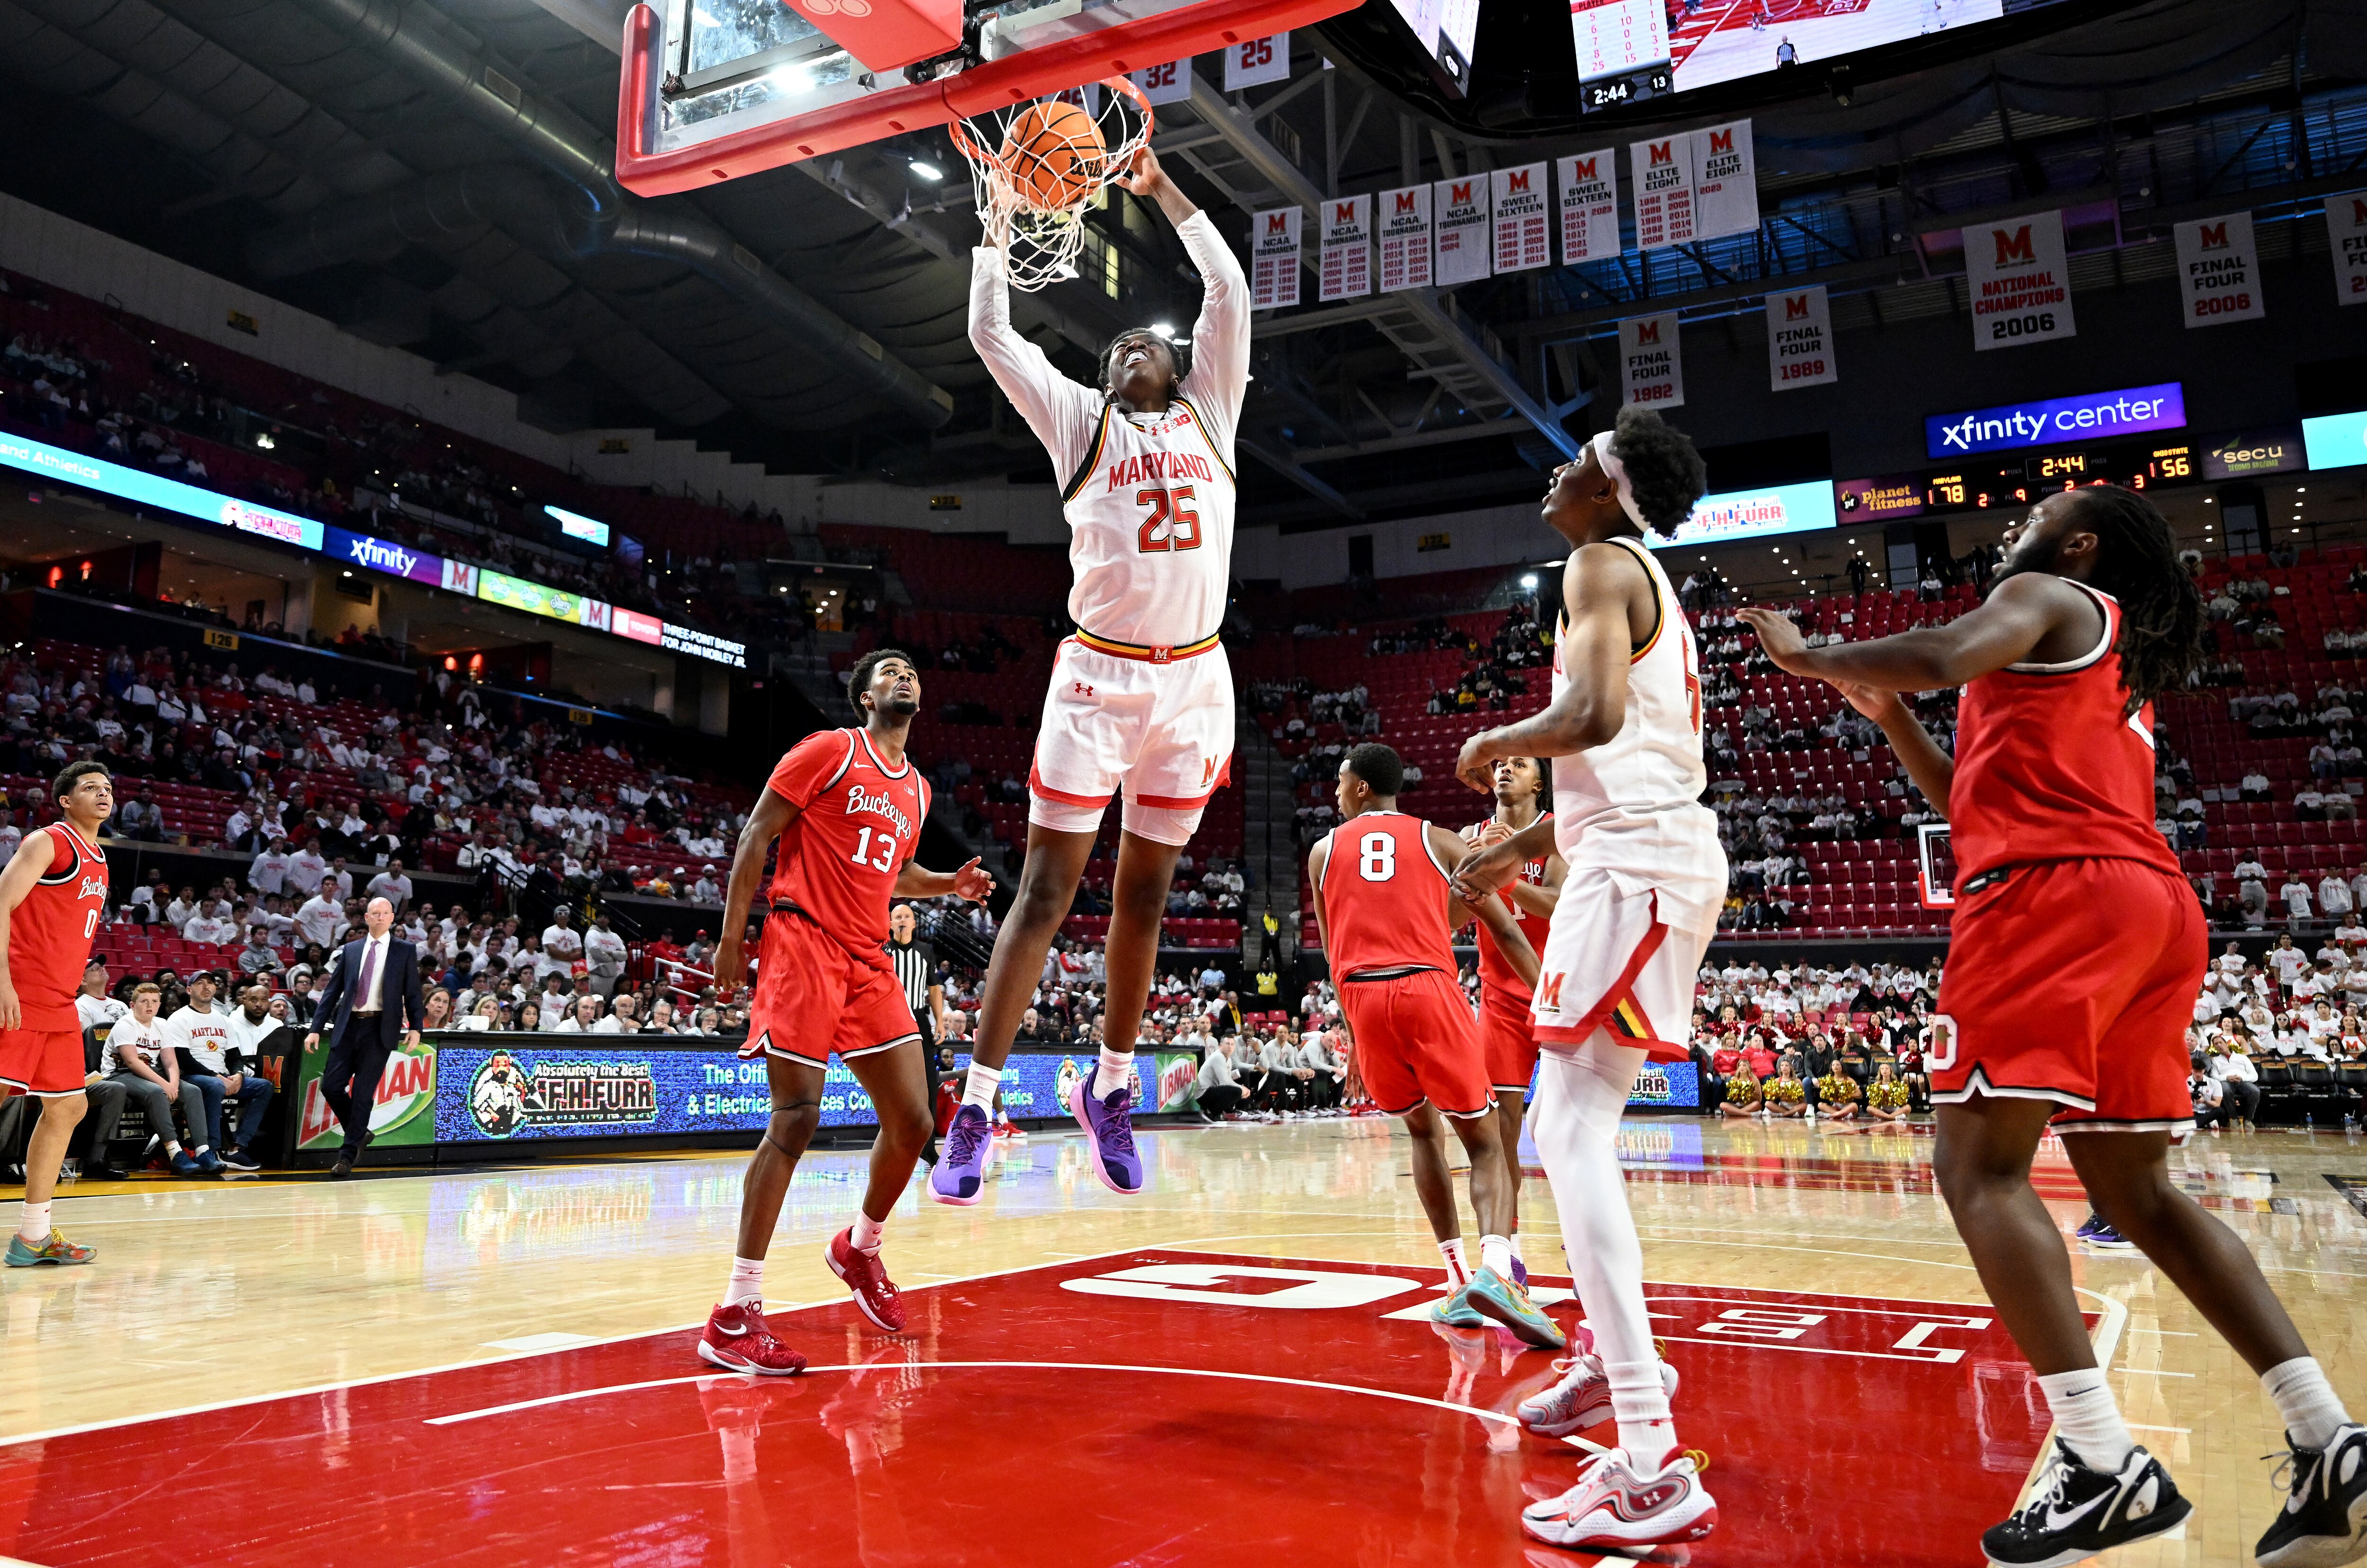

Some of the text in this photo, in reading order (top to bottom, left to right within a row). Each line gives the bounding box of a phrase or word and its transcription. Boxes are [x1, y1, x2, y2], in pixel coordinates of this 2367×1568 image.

[1590, 4, 1654, 21] 5 1 1
[1591, 16, 1656, 34] 6 10 0
[1593, 29, 1658, 45] 7 0 3
[1242, 37, 1272, 69] 25
[1594, 42, 1659, 58] 8 0 2
[1592, 53, 1636, 71] 25 15
[1146, 61, 1176, 89] 32
[1594, 76, 1666, 104] 2:44 13
[1709, 128, 1734, 153] M
[1648, 140, 1673, 165] M
[1707, 153, 1740, 169] ELITE
[1575, 157, 1597, 180] M
[1646, 167, 1679, 180] ELITE
[1706, 164, 1742, 179] EIGHT
[1509, 169, 1529, 192] M
[1568, 182, 1606, 196] SWEET
[1645, 176, 1681, 191] EIGHT
[1395, 191, 1415, 213] M
[1451, 182, 1471, 204] M
[1502, 194, 1538, 208] SWEET
[1564, 191, 1611, 207] SIXTEEN
[1336, 201, 1354, 223] M
[1391, 215, 1419, 227] NCAA
[1447, 206, 1476, 219] NCAA
[1497, 203, 1543, 218] SIXTEEN
[1268, 213, 1286, 233] M
[1331, 226, 1359, 237] NCAA
[1383, 223, 1428, 237] TOURNAMENT
[1439, 214, 1486, 230] TOURNAMENT
[1263, 237, 1290, 247] NCAA
[1323, 233, 1367, 247] TOURNAMENT
[1992, 224, 2036, 265] M
[2200, 222, 2229, 249] M
[1255, 244, 1298, 257] TOURNAMENT
[2189, 256, 2246, 276] FINAL
[1982, 271, 2055, 297] NATIONAL
[2194, 271, 2245, 290] FOUR
[1785, 295, 1810, 320] M
[1975, 288, 2064, 315] CHAMPIONS
[2195, 293, 2251, 317] 2006
[1637, 321, 1660, 345] M
[1776, 325, 1823, 343] FINAL
[1992, 312, 2055, 339] 2006
[1780, 339, 1822, 357] FOUR
[1628, 350, 1672, 368] FINAL
[1631, 364, 1671, 381] FOUR
[1780, 359, 1824, 381] 1989
[1632, 383, 1673, 403] 1982
[1942, 396, 2164, 450] xfinity center
[2224, 445, 2282, 463] secu
[32, 451, 100, 480] Athletics
[1108, 451, 1212, 493] MARYLAND
[2042, 456, 2084, 477] 2:44
[2162, 457, 2189, 477] 56
[1933, 475, 1961, 485] MARYLAND
[1862, 484, 1911, 504] planet
[1940, 485, 1964, 503] 78
[1978, 493, 1987, 507] 2
[2016, 489, 2025, 501] 9
[2065, 481, 2074, 492] 2
[2135, 475, 2144, 488] 3
[1869, 496, 1921, 511] fitness
[1136, 485, 1201, 552] 25
[350, 537, 417, 577] xfinity
[452, 561, 469, 589] M
[588, 599, 603, 625] M
[630, 621, 660, 636] TOYOTA
[663, 623, 746, 655] THREE-POINT BASKET
[211, 632, 231, 647] 126
[661, 635, 746, 668] FOR JOHN MOBLEY JR.
[1154, 649, 1168, 659] M
[1201, 754, 1218, 784] M
[846, 784, 912, 839] Buckeyes
[851, 827, 897, 873] 13
[1359, 831, 1396, 882] 8
[77, 875, 107, 910] Buckey
[84, 909, 97, 939] 0
[1540, 971, 1566, 1007] M
[535, 1064, 597, 1078] Absolutely
[600, 1065, 619, 1076] the
[704, 1064, 767, 1085] The Offi
[1158, 1059, 1197, 1108] LIBMAN
[687, 1093, 771, 1115] & Electrica
